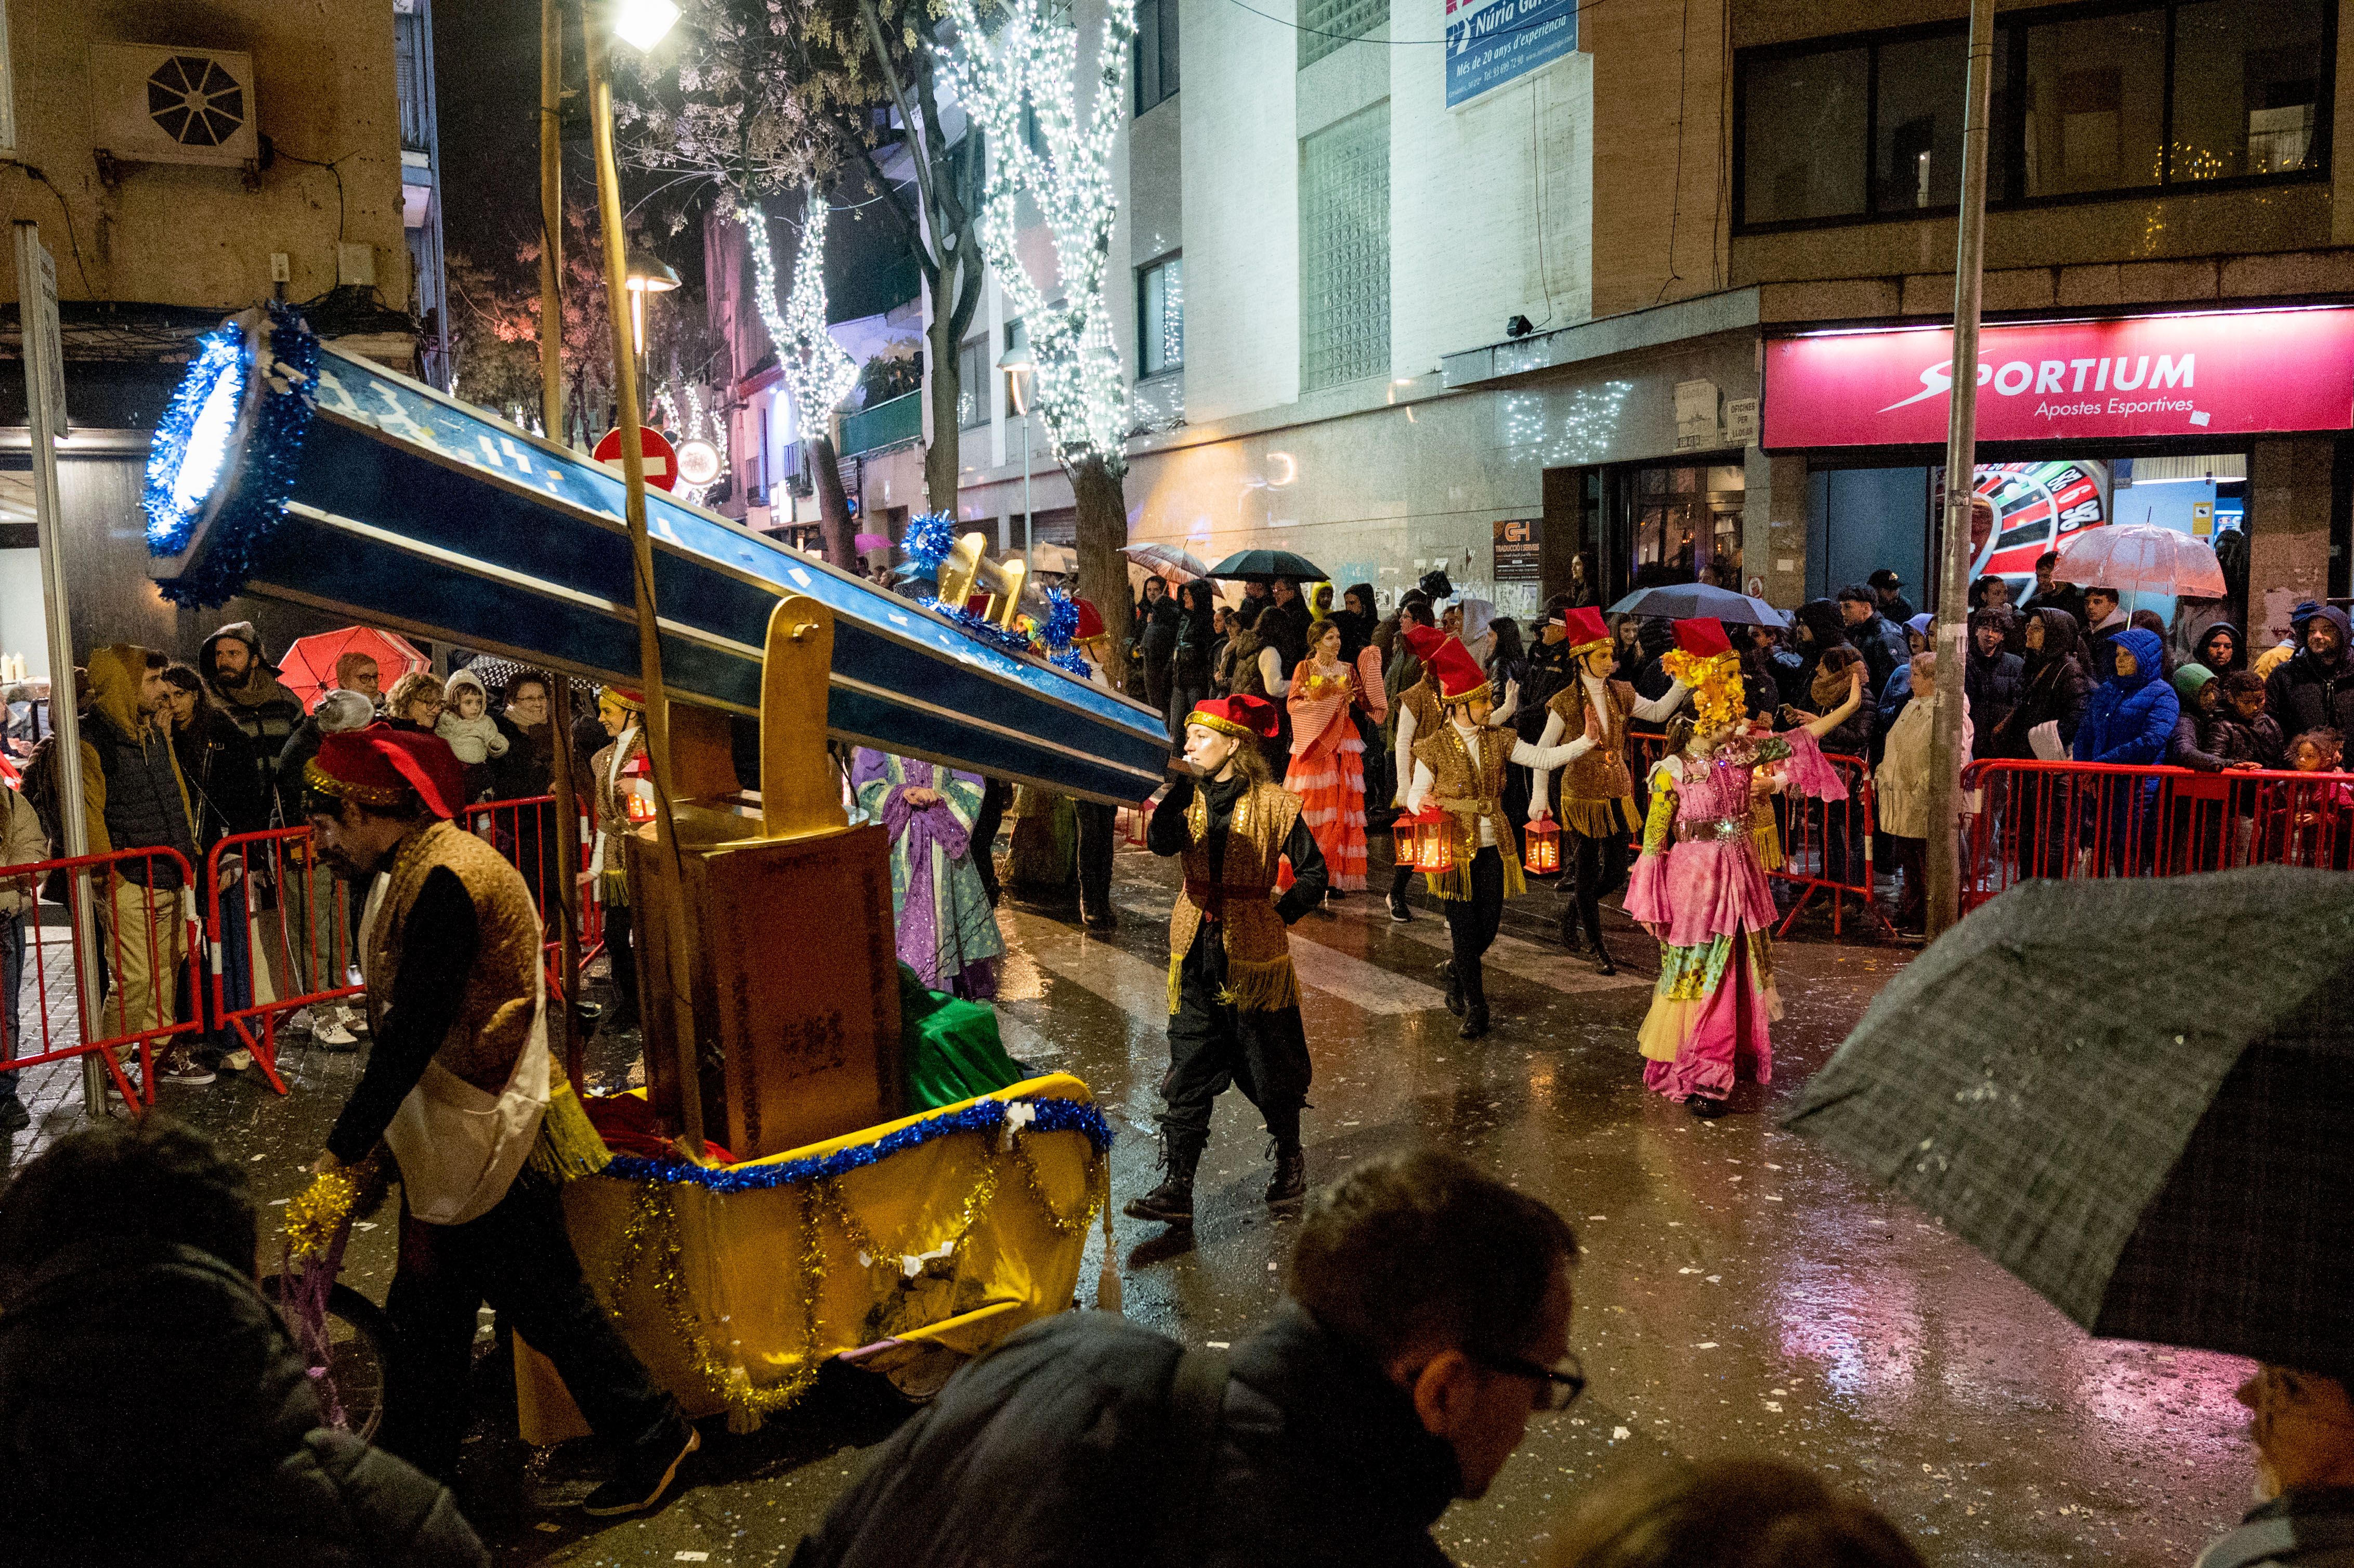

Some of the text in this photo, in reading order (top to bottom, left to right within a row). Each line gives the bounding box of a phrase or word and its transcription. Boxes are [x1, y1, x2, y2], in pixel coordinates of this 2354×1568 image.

[1475, 1, 1514, 37] Núria
[1457, 61, 1470, 77] Més
[1472, 55, 1481, 70] de
[1482, 49, 1492, 65] 20
[1494, 42, 1512, 58] anys
[1493, 66, 1500, 77] 93
[1500, 61, 1509, 74] 699
[1510, 58, 1516, 69] 72
[1875, 349, 2195, 414] SPORTIUM
[1731, 402, 1755, 413] OFICINES
[2034, 396, 2193, 421] Apostes Esportives
[2047, 468, 2081, 492] 28
[1496, 543, 1520, 552] TRADUCCIÓ
